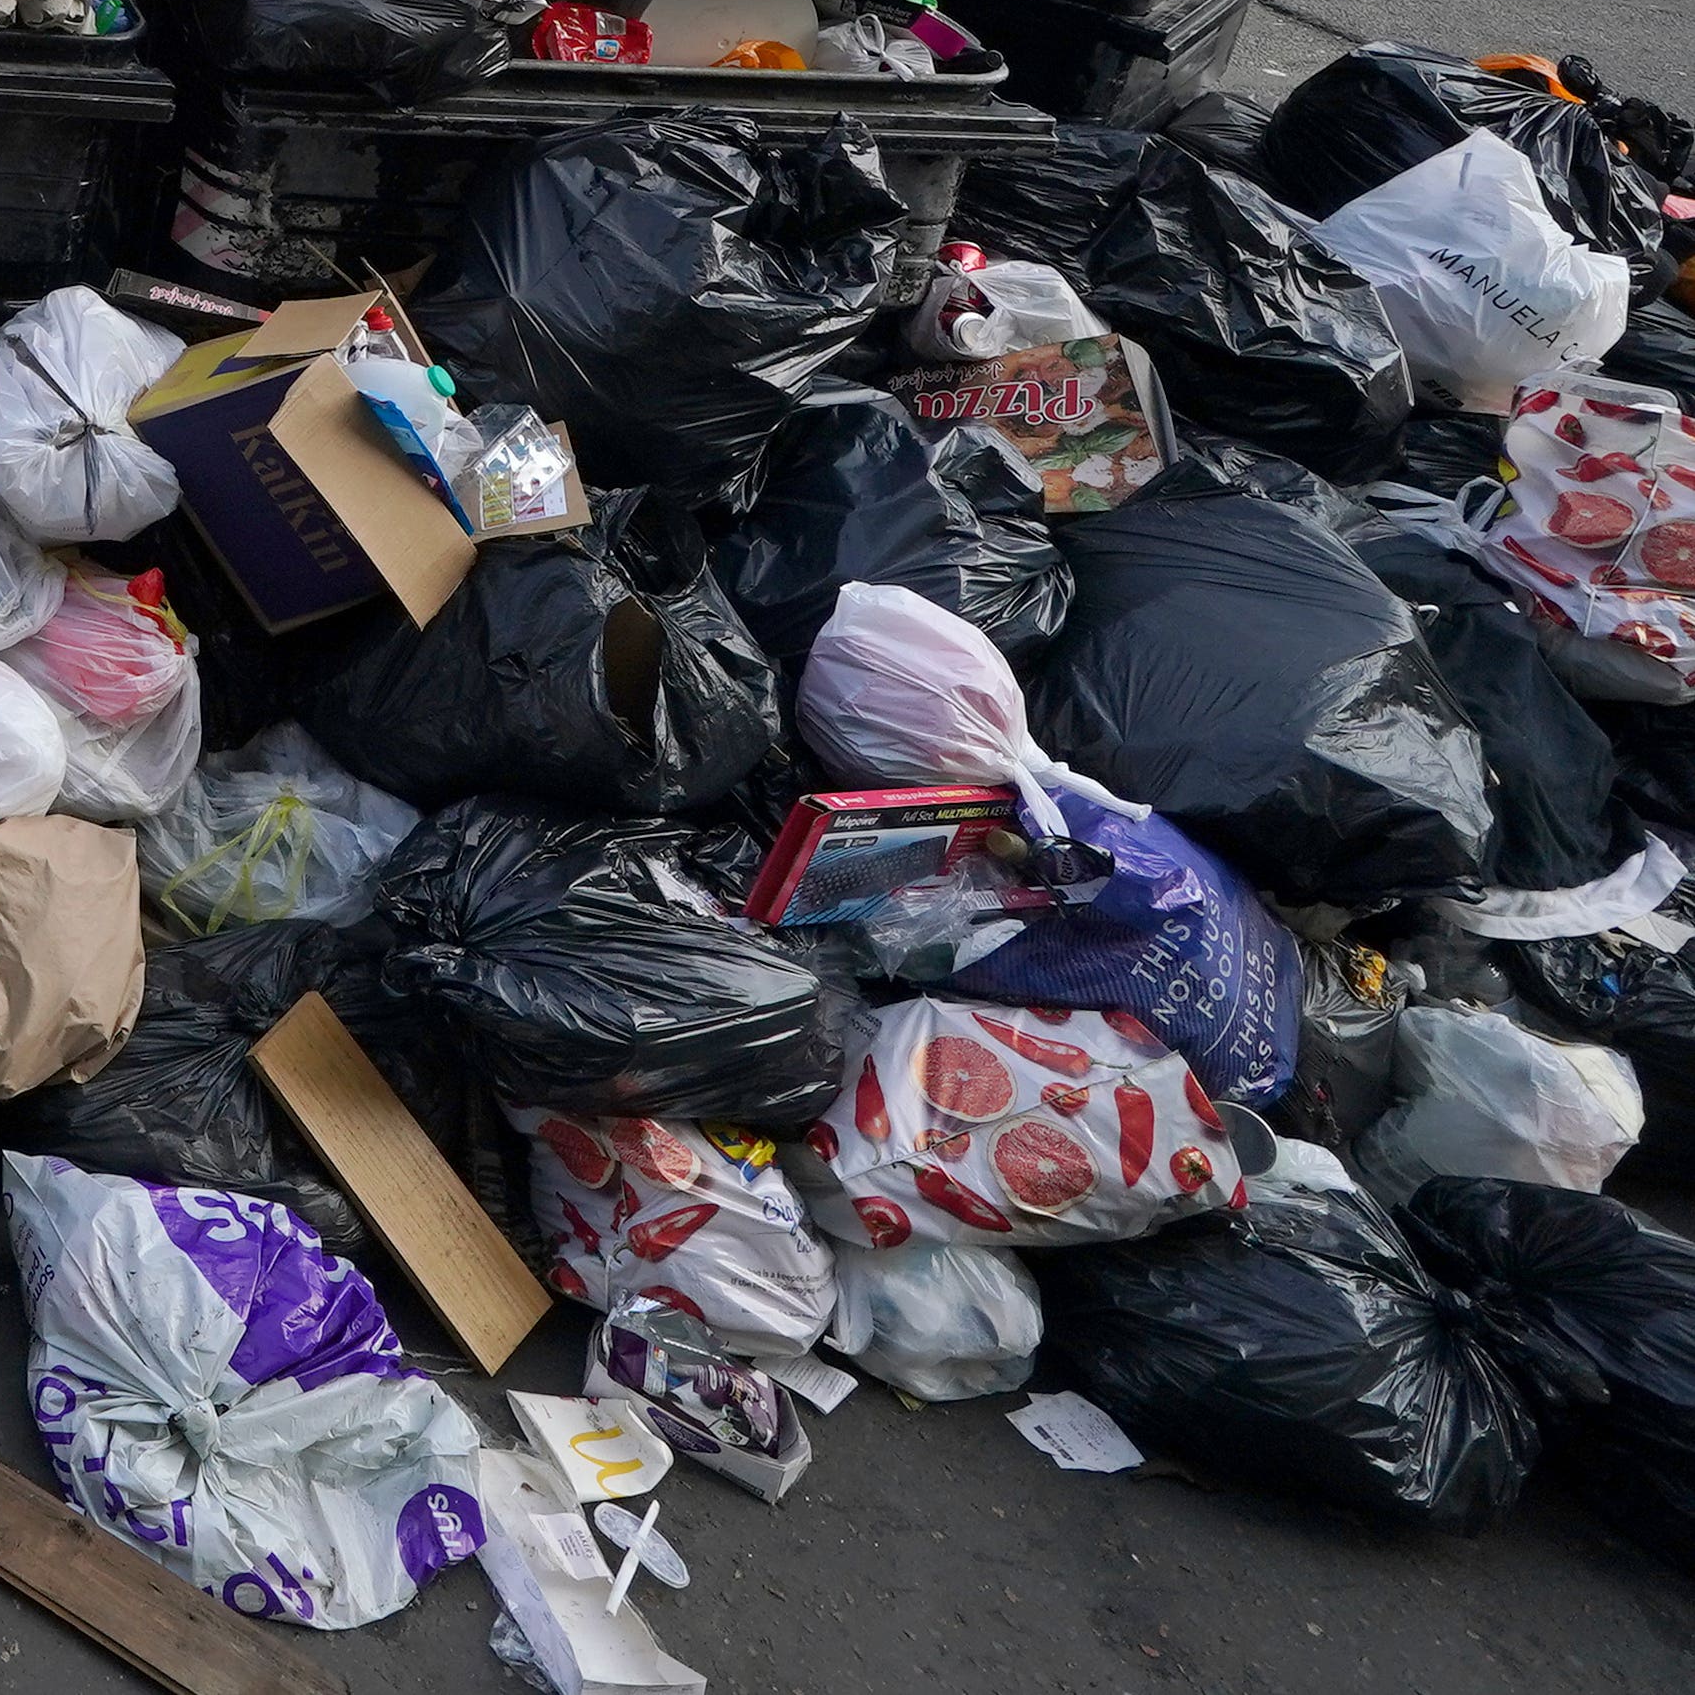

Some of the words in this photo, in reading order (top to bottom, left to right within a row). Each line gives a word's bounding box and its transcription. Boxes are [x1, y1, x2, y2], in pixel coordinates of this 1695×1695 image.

[1430, 247, 1561, 350] MANUELA
[914, 377, 1095, 425] Pizza
[935, 805, 990, 820] MULTIMEDIA
[1130, 917, 1191, 984] THIS
[1151, 960, 1202, 1026] NOT
[1199, 880, 1220, 962] JUST
[1195, 930, 1235, 1020] FOOD
[1228, 1041, 1274, 1101] M&S
[1263, 940, 1276, 1033] FOOD
[1229, 989, 1262, 1059] THIS
[1246, 950, 1262, 985] IS
